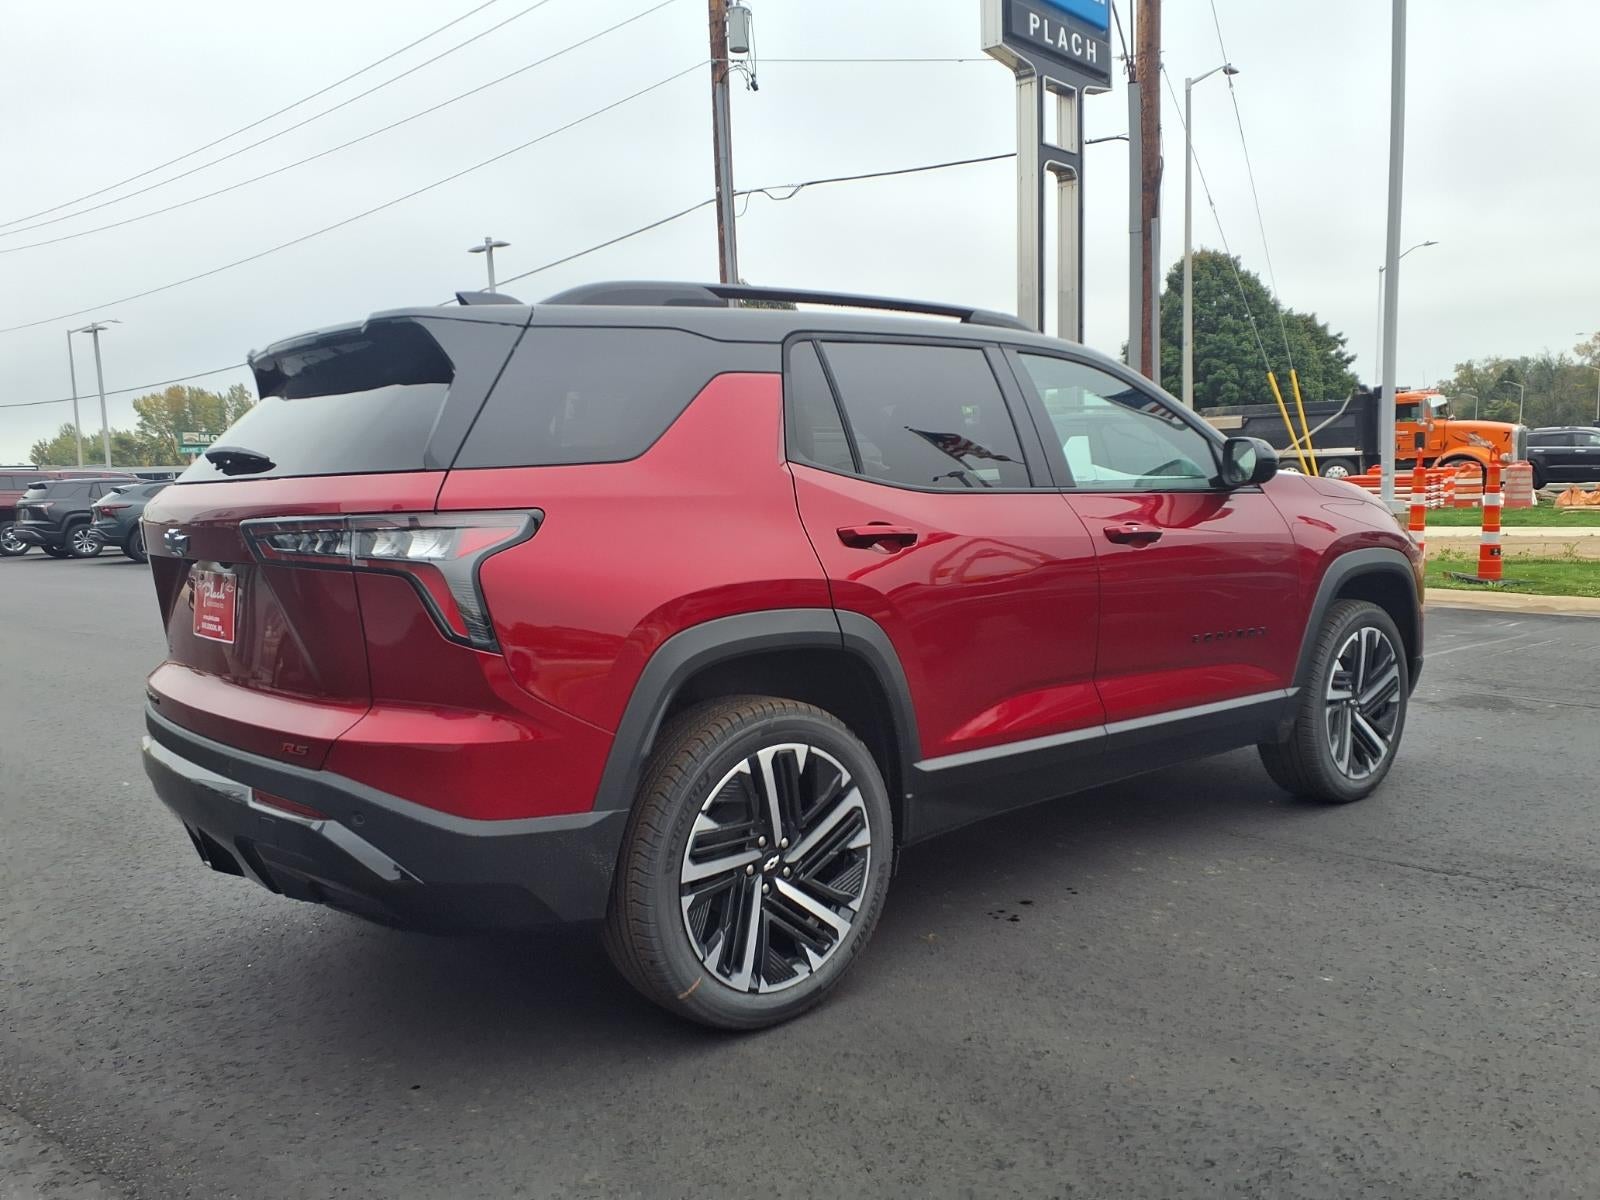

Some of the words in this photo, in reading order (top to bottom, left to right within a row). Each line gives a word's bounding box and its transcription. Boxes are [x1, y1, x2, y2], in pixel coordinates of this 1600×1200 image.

[1029, 12, 1097, 63] PLACH
[1503, 431, 1511, 442] 7
[281, 742, 308, 755] RS
